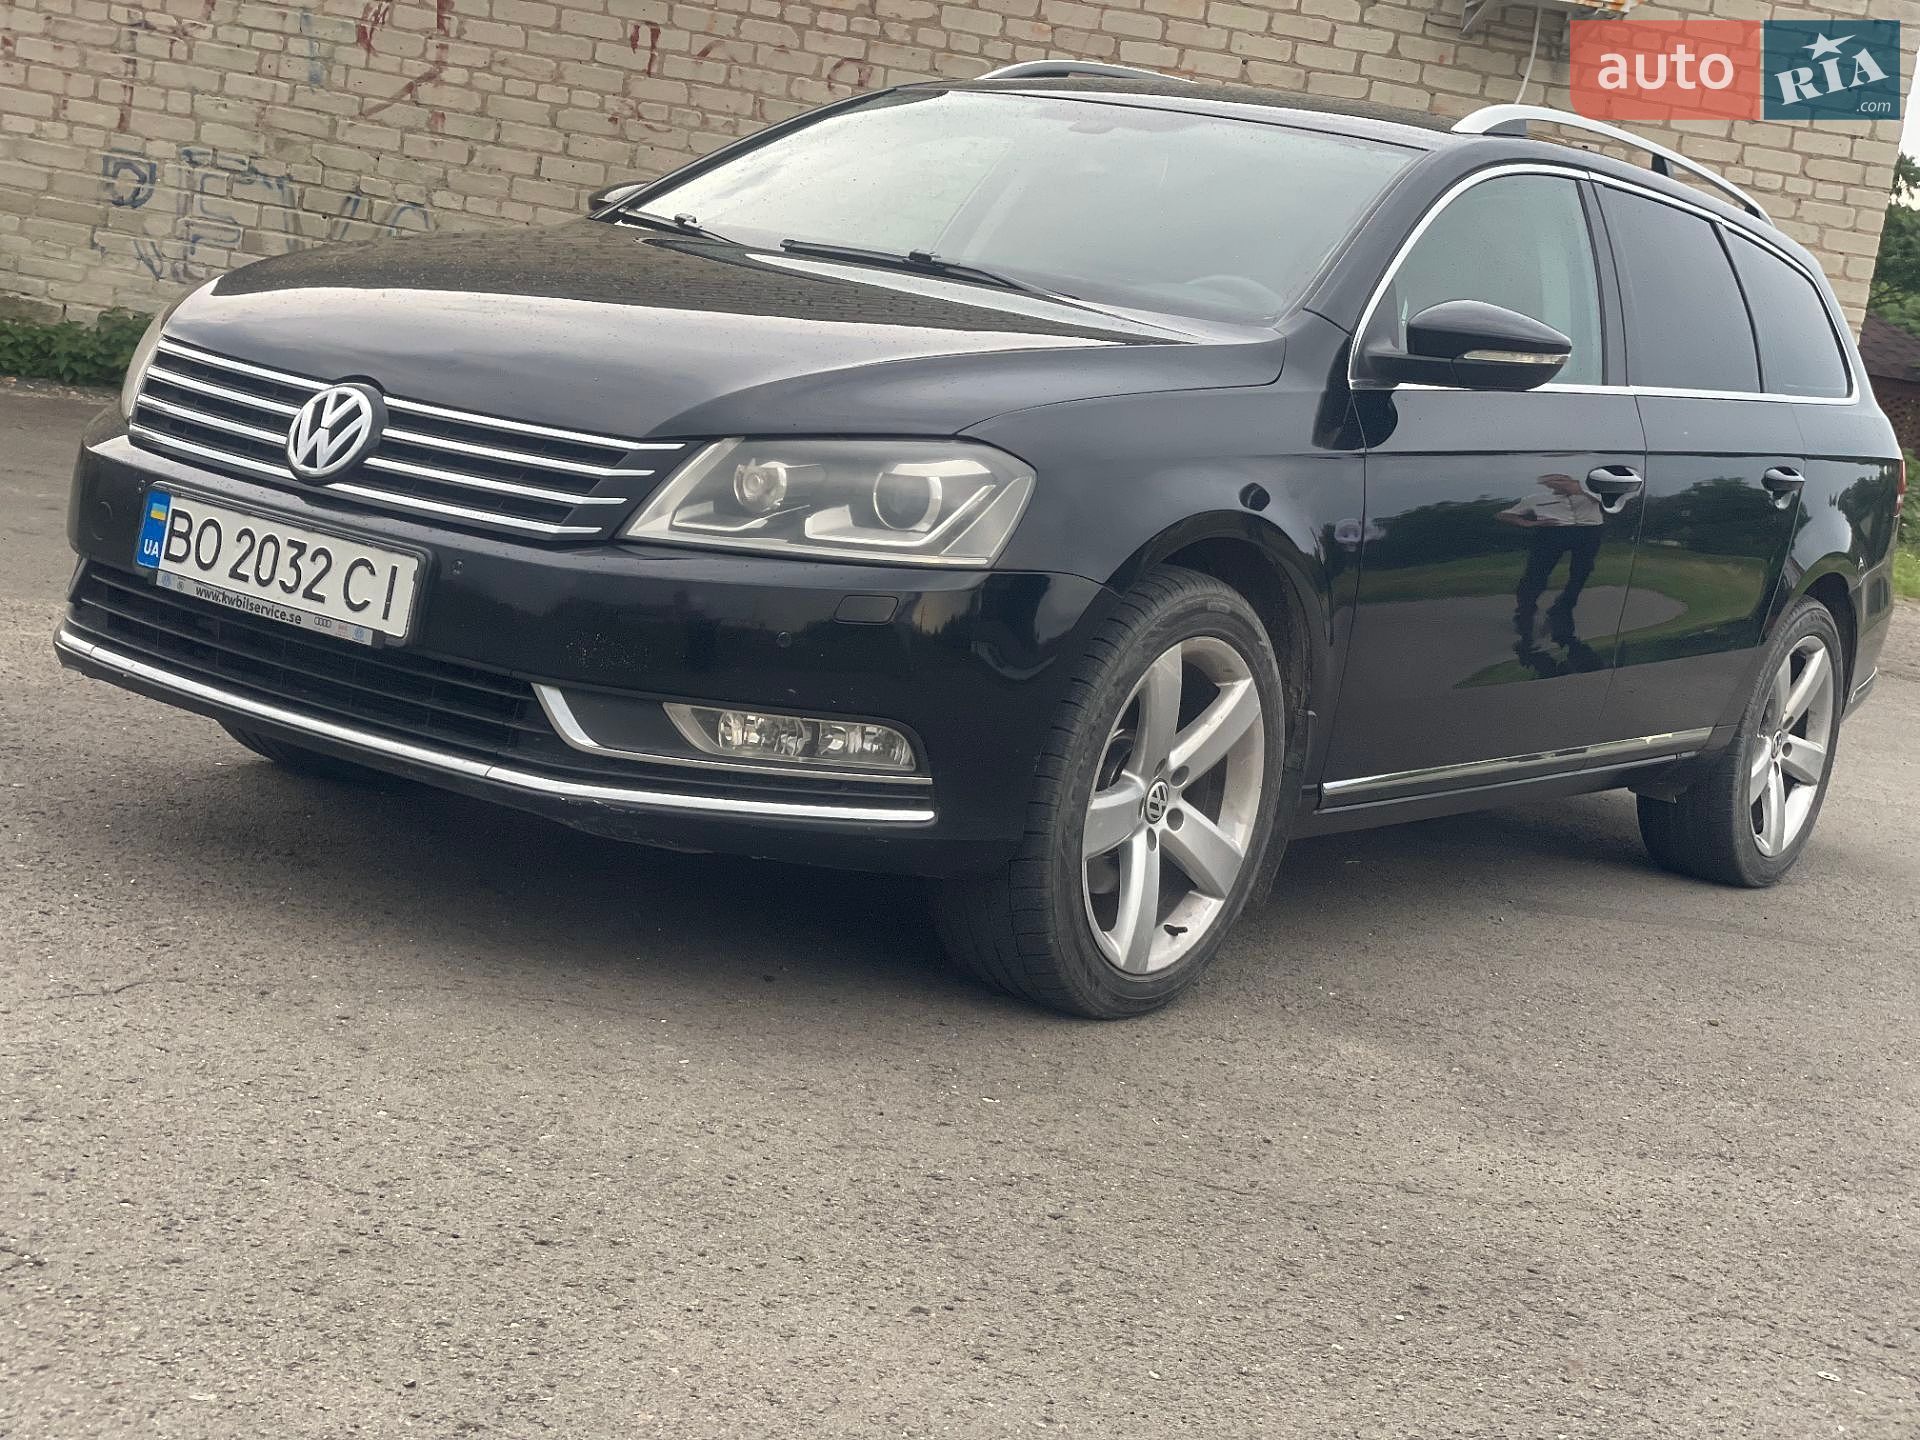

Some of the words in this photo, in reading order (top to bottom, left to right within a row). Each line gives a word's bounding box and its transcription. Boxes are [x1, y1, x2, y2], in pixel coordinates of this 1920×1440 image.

[143, 539, 160, 558] UA
[163, 508, 223, 571] BO
[228, 527, 333, 604] 2032
[343, 557, 398, 620] CI
[195, 585, 302, 625] www.kwbilservice.se
